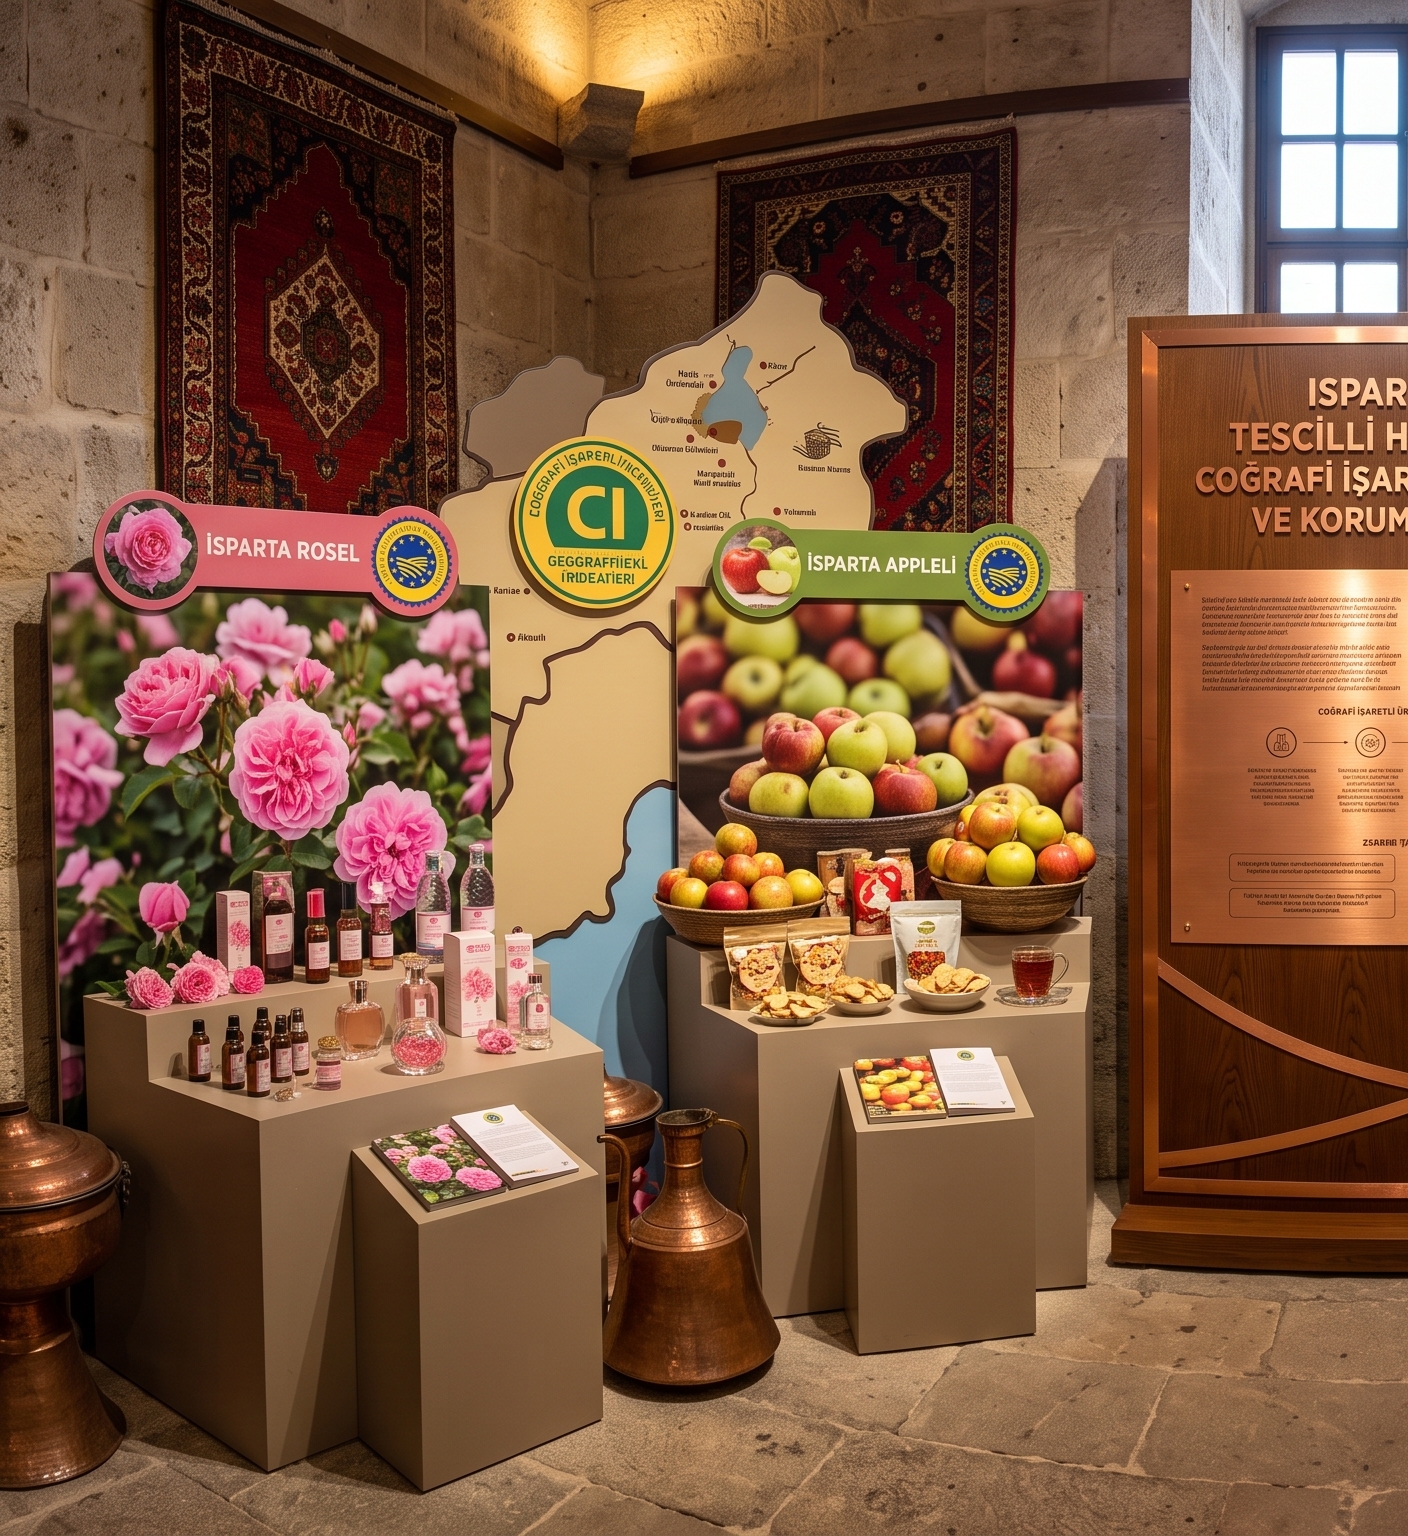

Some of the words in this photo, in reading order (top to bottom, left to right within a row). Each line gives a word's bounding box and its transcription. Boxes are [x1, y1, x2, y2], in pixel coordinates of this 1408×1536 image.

[1229, 415, 1374, 452] TESCİLLİ
[1196, 460, 1333, 494] COĞRAFİ
[566, 485, 625, 540] CI
[1252, 507, 1291, 534] VE
[206, 531, 291, 559] İSPARTA
[298, 540, 360, 563] ROSEL
[807, 551, 881, 573] İSPARTA
[885, 557, 956, 574] APPLELİ
[1318, 706, 1355, 715] COĞRAFİ
[1357, 706, 1395, 716] İŞARETLİ
